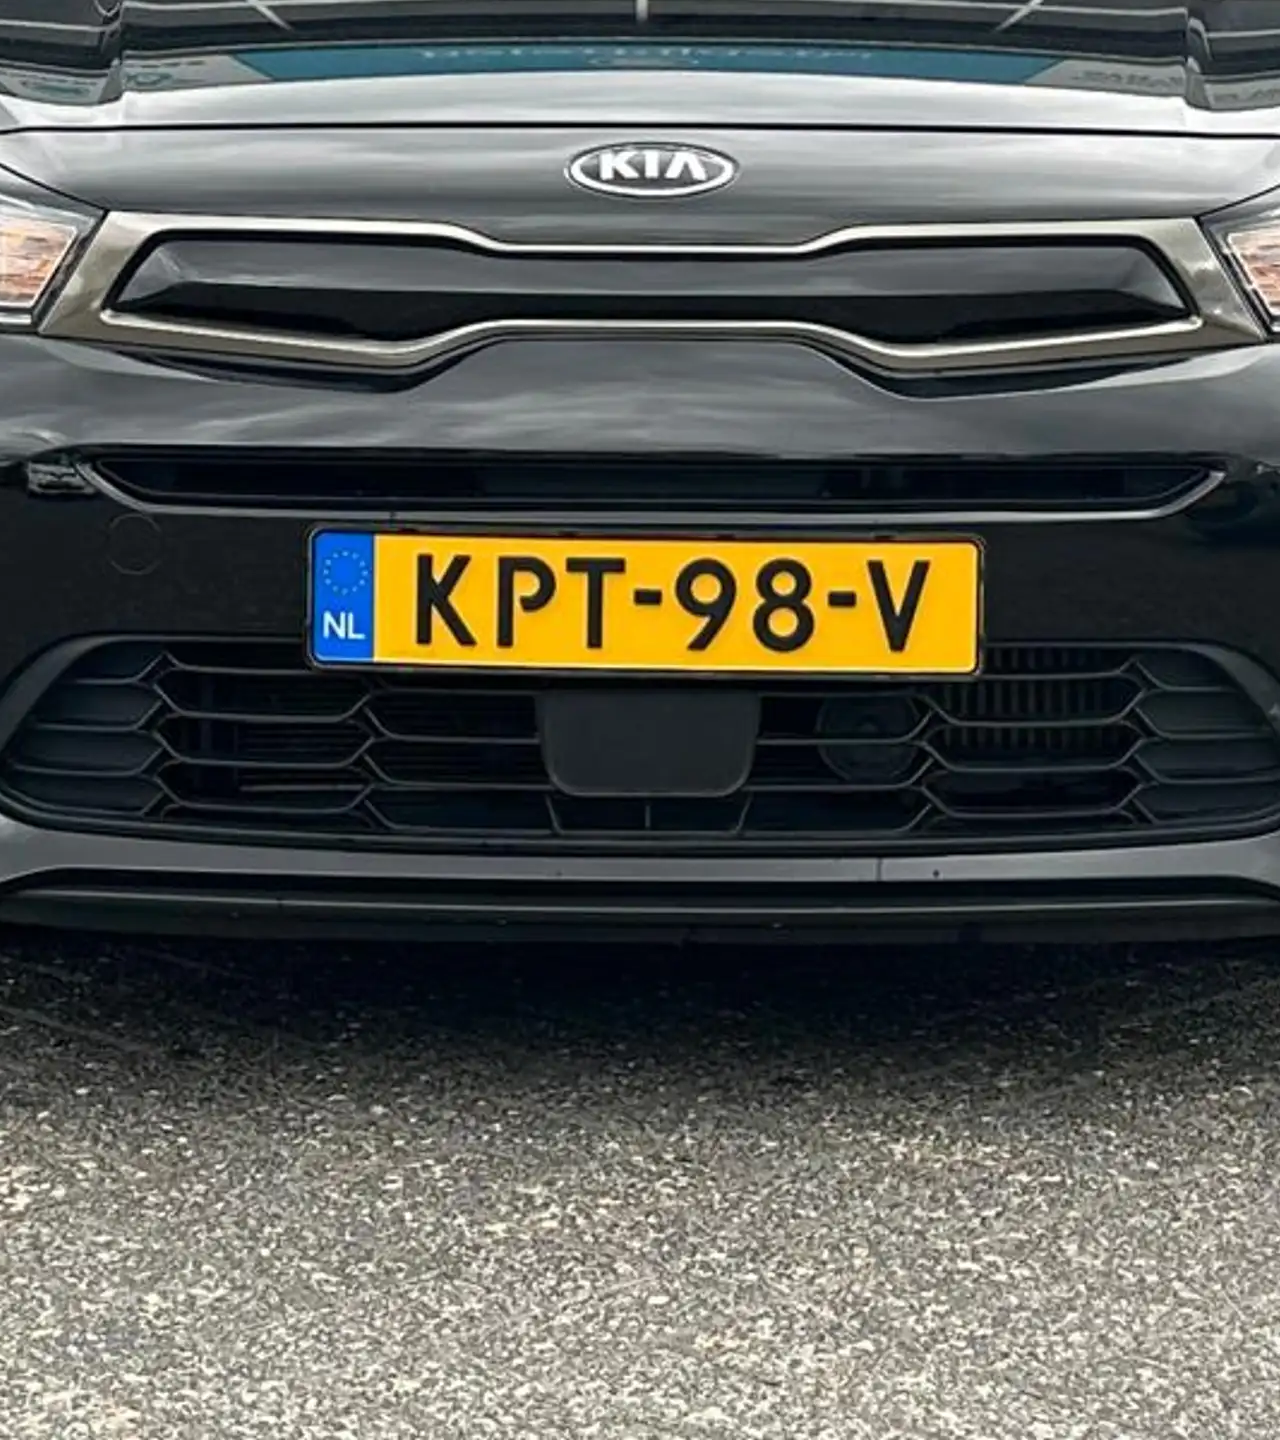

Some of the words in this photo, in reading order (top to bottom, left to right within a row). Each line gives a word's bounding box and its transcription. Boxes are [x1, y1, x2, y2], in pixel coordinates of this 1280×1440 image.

[598, 148, 708, 181] KIA
[414, 553, 930, 653] KPT-98-V
[322, 611, 366, 641] NL
